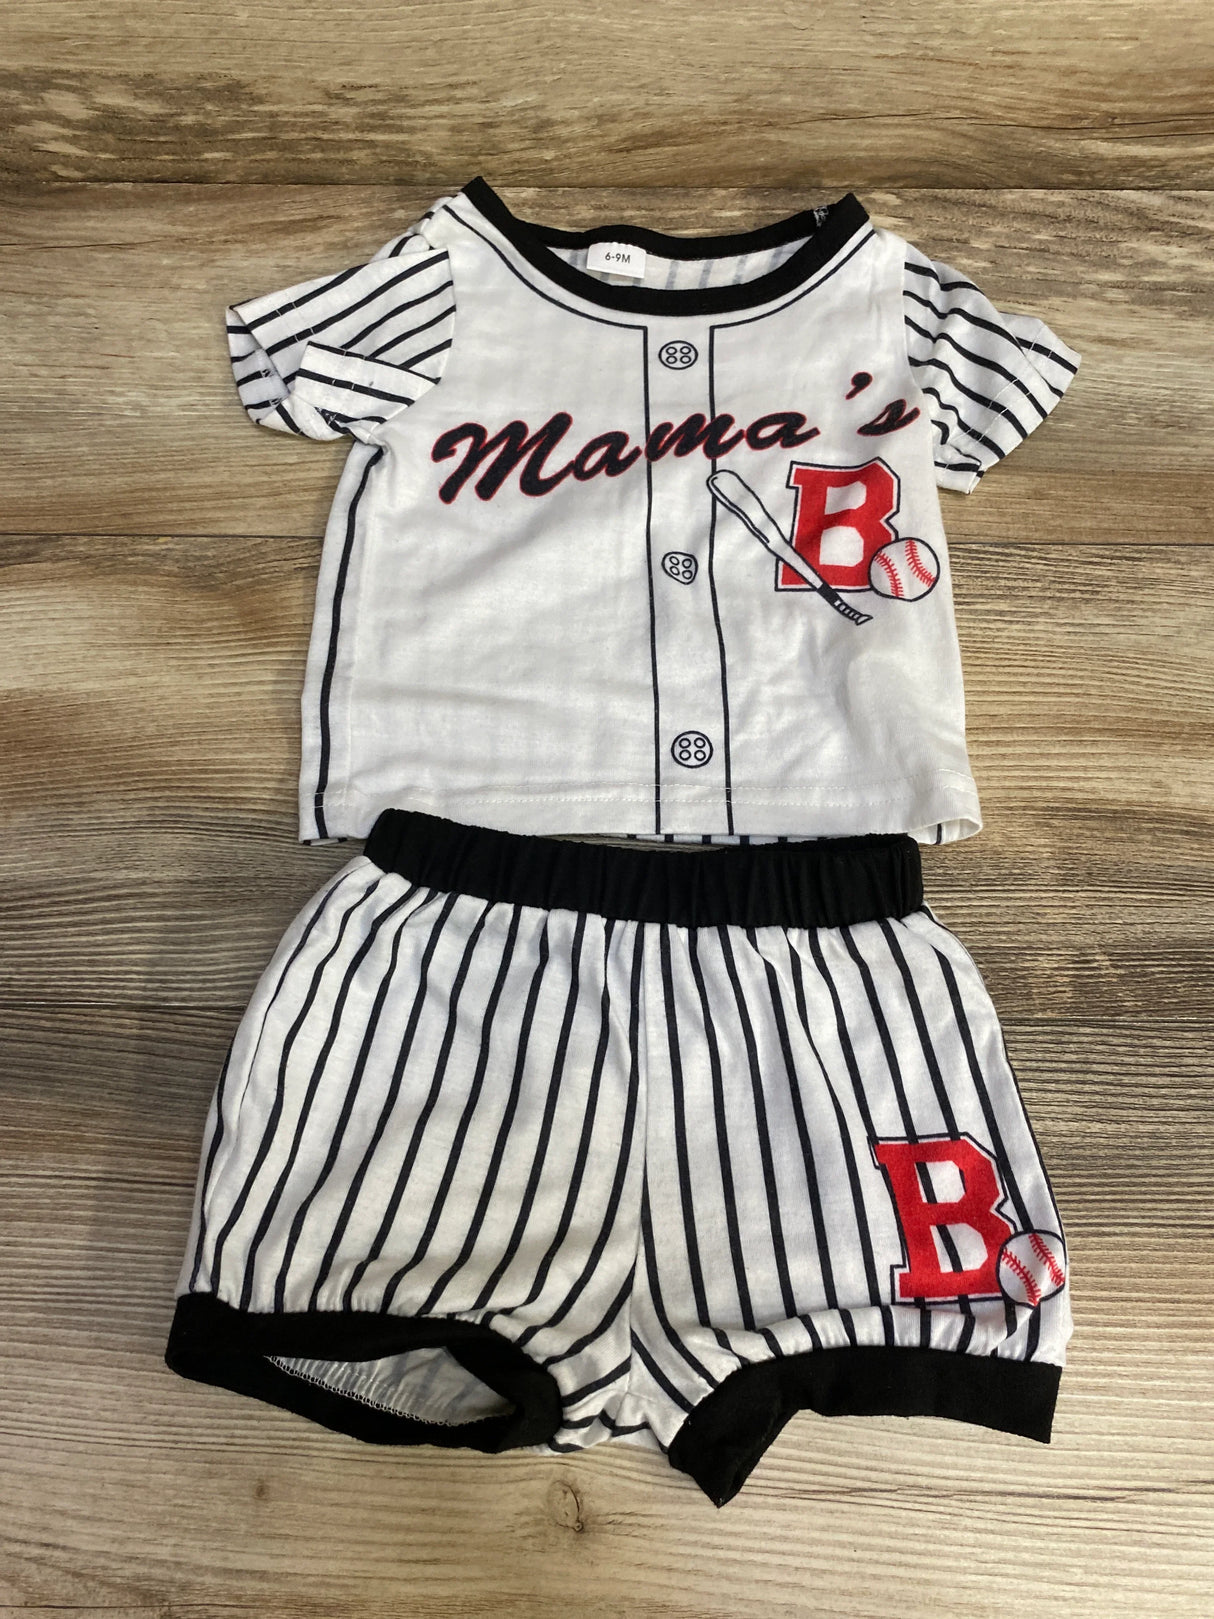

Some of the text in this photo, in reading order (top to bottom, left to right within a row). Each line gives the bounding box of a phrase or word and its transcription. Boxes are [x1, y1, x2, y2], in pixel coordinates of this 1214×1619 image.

[604, 251, 631, 264] 6-9M
[431, 371, 921, 505] Mama's
[775, 456, 901, 592] B
[867, 1131, 1018, 1306] B
